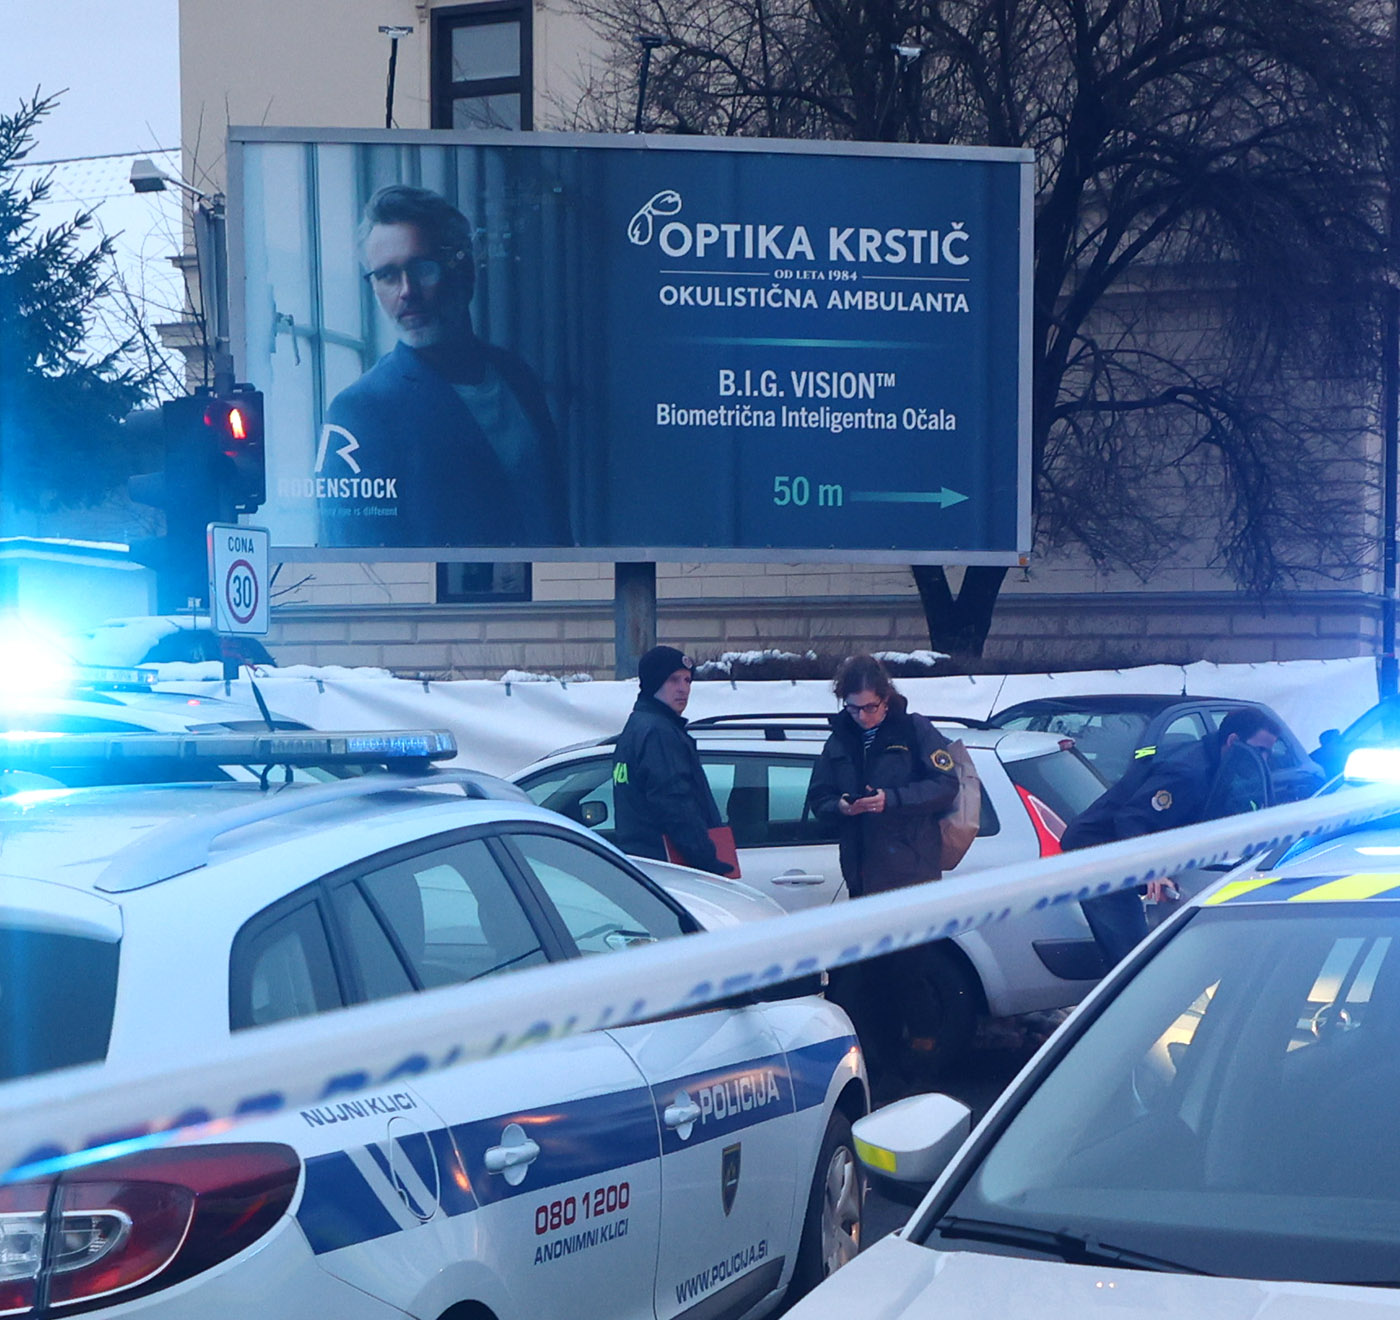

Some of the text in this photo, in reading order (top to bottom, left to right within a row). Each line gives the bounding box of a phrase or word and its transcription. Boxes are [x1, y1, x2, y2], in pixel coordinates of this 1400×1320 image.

[658, 221, 970, 265] OPTIKA KRSTIČ
[774, 268, 858, 282] OD LETA 1984
[659, 284, 970, 313] OKULISTIČNA AMBULANTA
[719, 369, 785, 398] B.I.G.
[656, 403, 956, 433] Biometrična Inteligentna Očala
[278, 478, 398, 498] RODENSTOCK
[773, 476, 843, 506] 50 m
[228, 536, 254, 554] CONA
[233, 575, 252, 608] 30
[300, 1092, 417, 1128] NUJNI KLICI
[700, 1070, 780, 1125] POLICIJA
[535, 1181, 629, 1235] 080 1200
[533, 1218, 629, 1266] ANONIMNI KLICI
